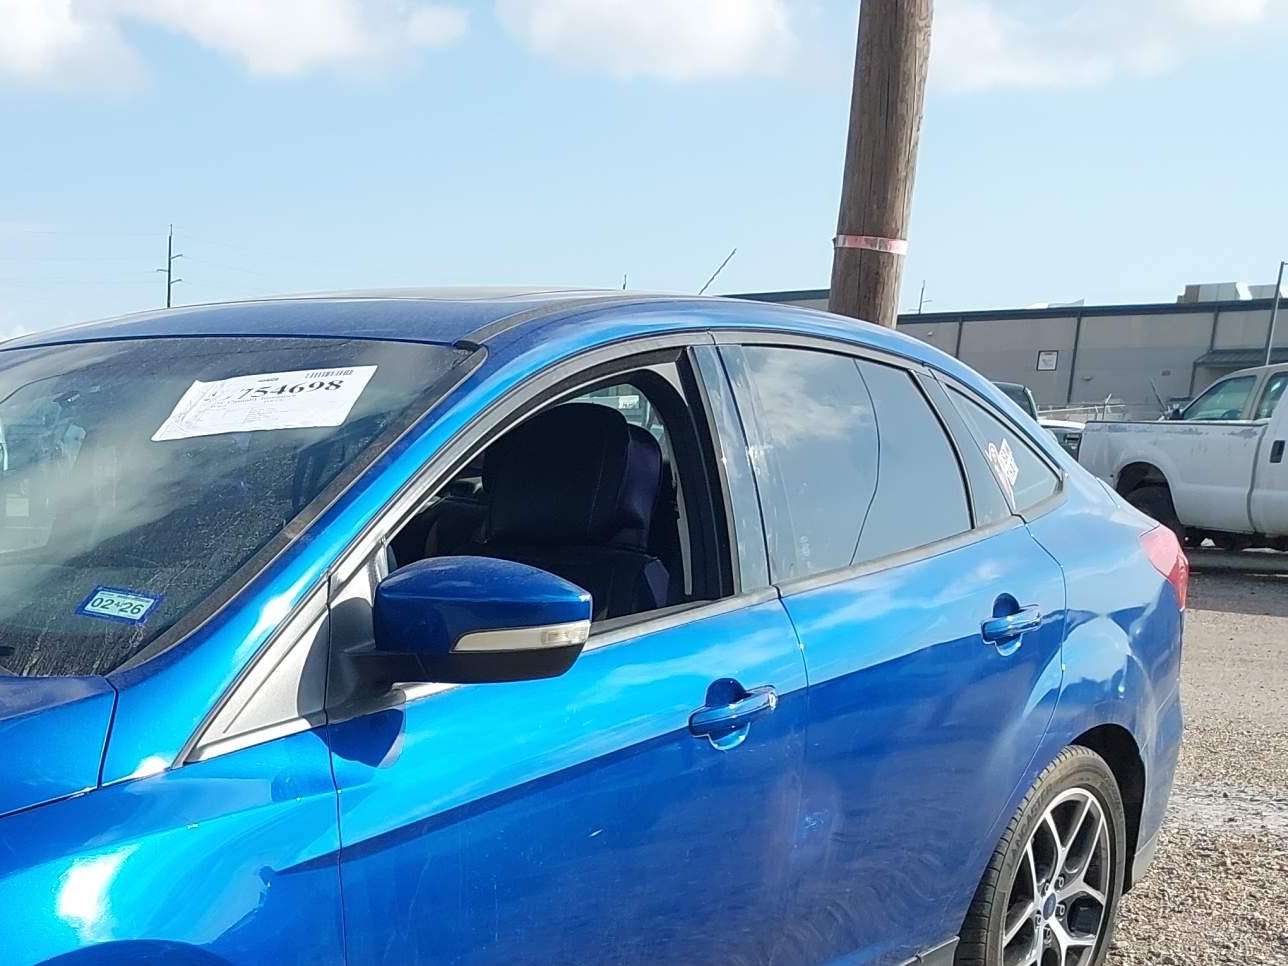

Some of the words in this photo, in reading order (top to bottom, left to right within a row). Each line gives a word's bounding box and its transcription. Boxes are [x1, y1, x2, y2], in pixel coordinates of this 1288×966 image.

[203, 379, 344, 402] 754698
[91, 597, 114, 610] 02
[118, 601, 144, 615] 26
